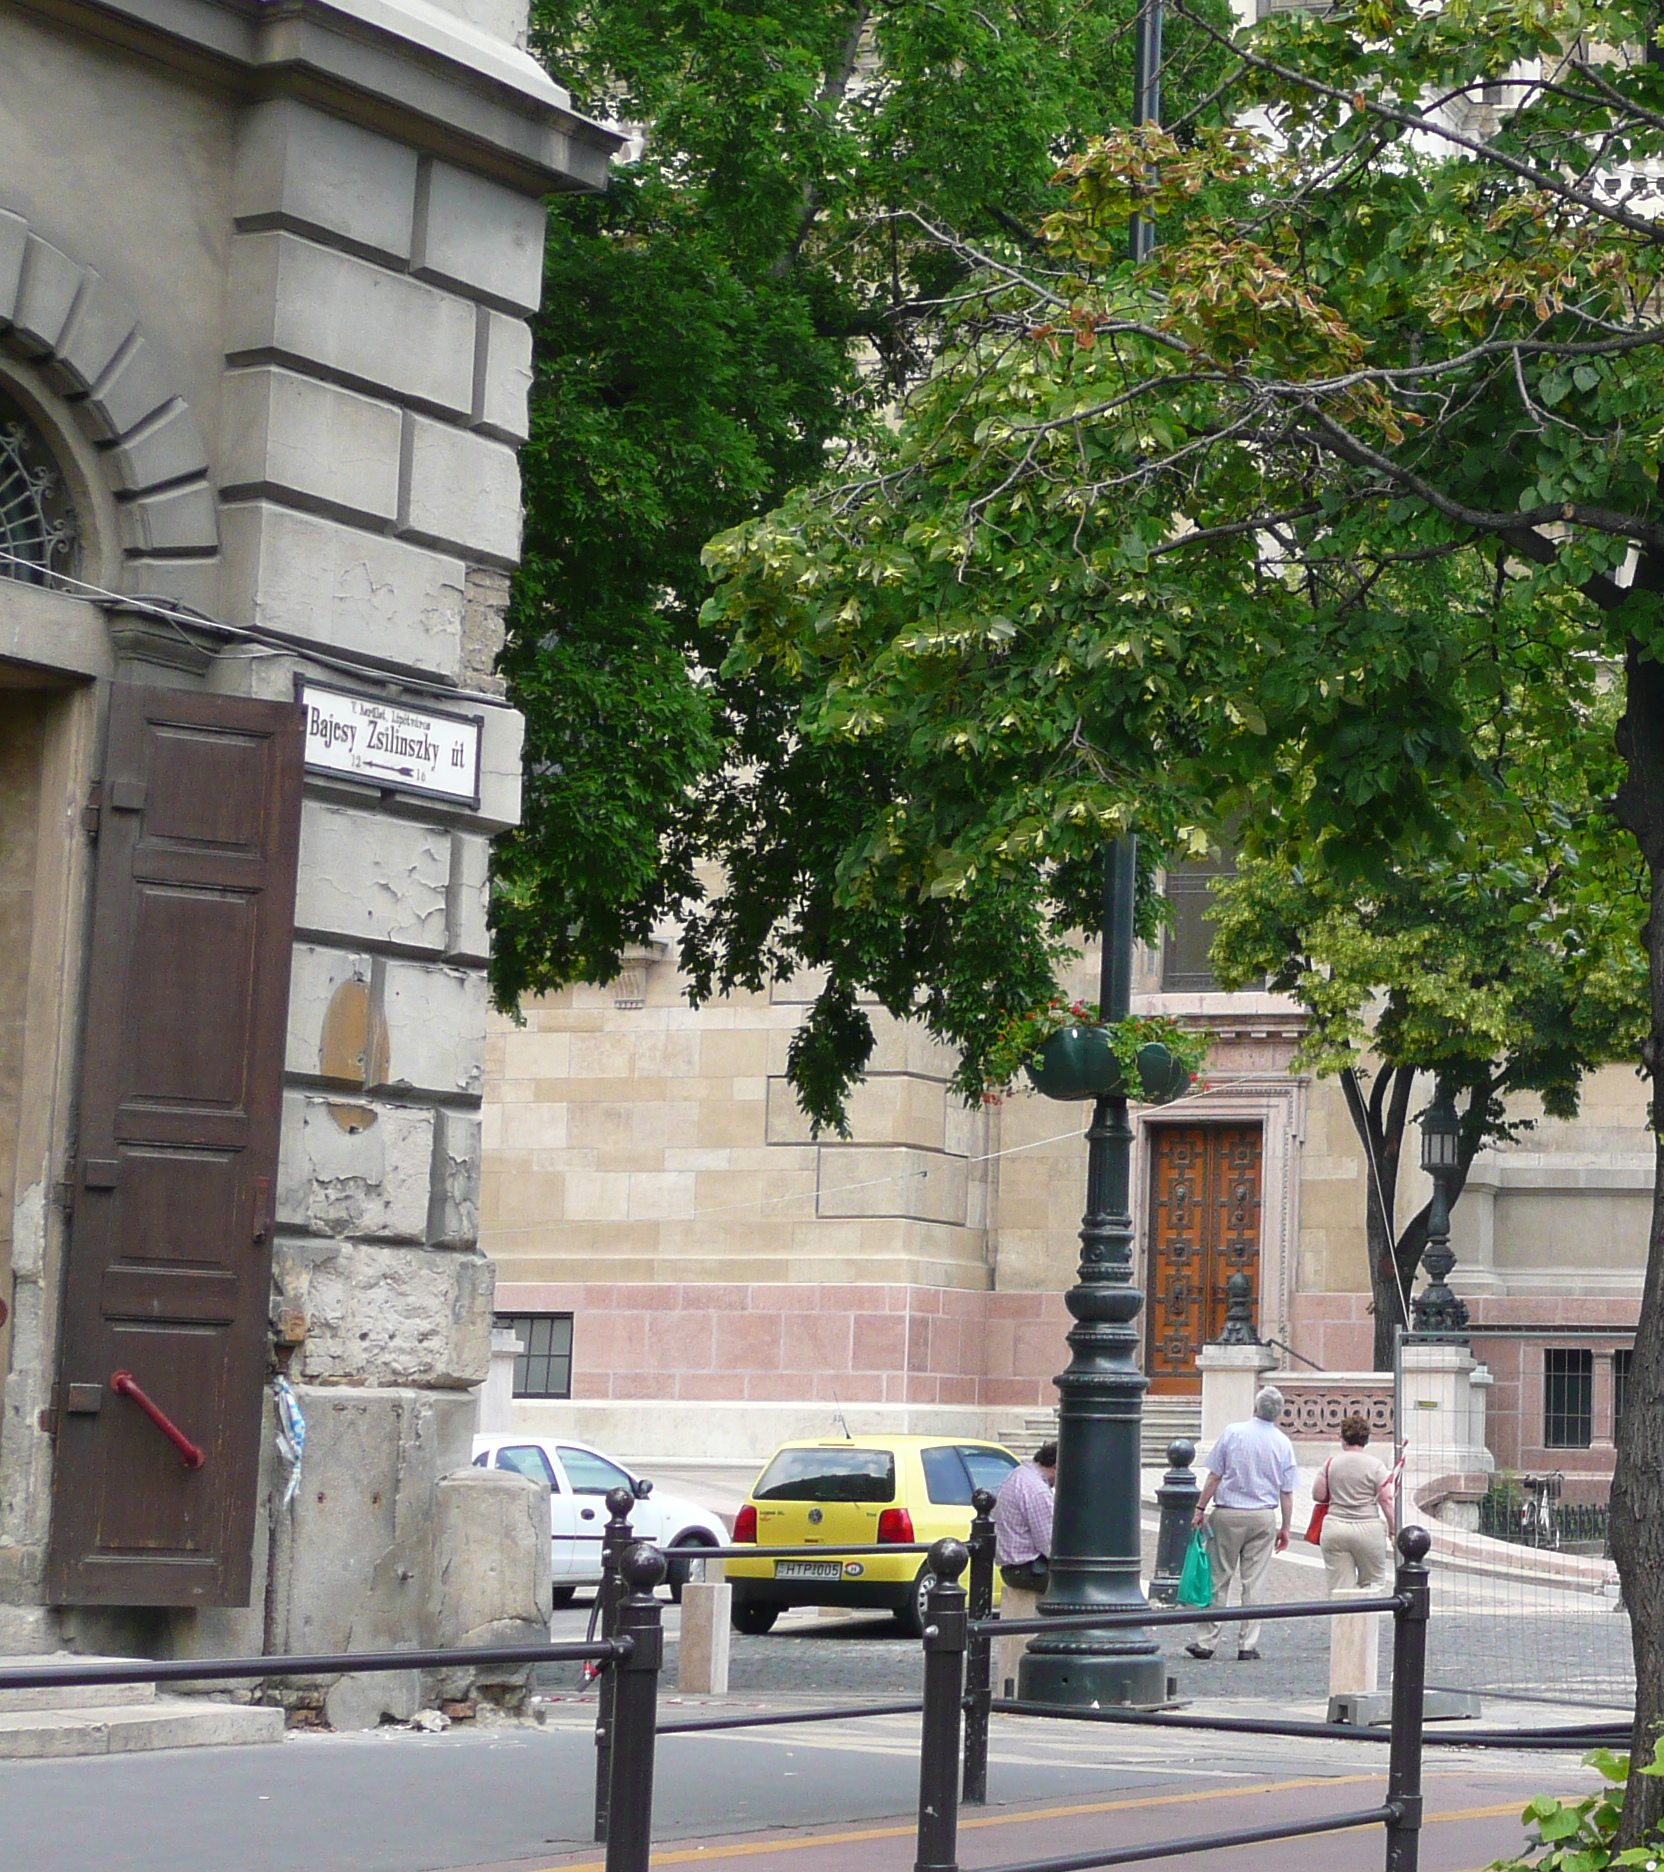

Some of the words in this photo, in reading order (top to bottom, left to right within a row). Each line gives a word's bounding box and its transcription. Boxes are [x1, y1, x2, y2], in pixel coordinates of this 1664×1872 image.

[310, 706, 357, 753] Bajcsy
[367, 719, 439, 771] Zsilinszky
[451, 740, 465, 768] út
[351, 754, 361, 768] 12
